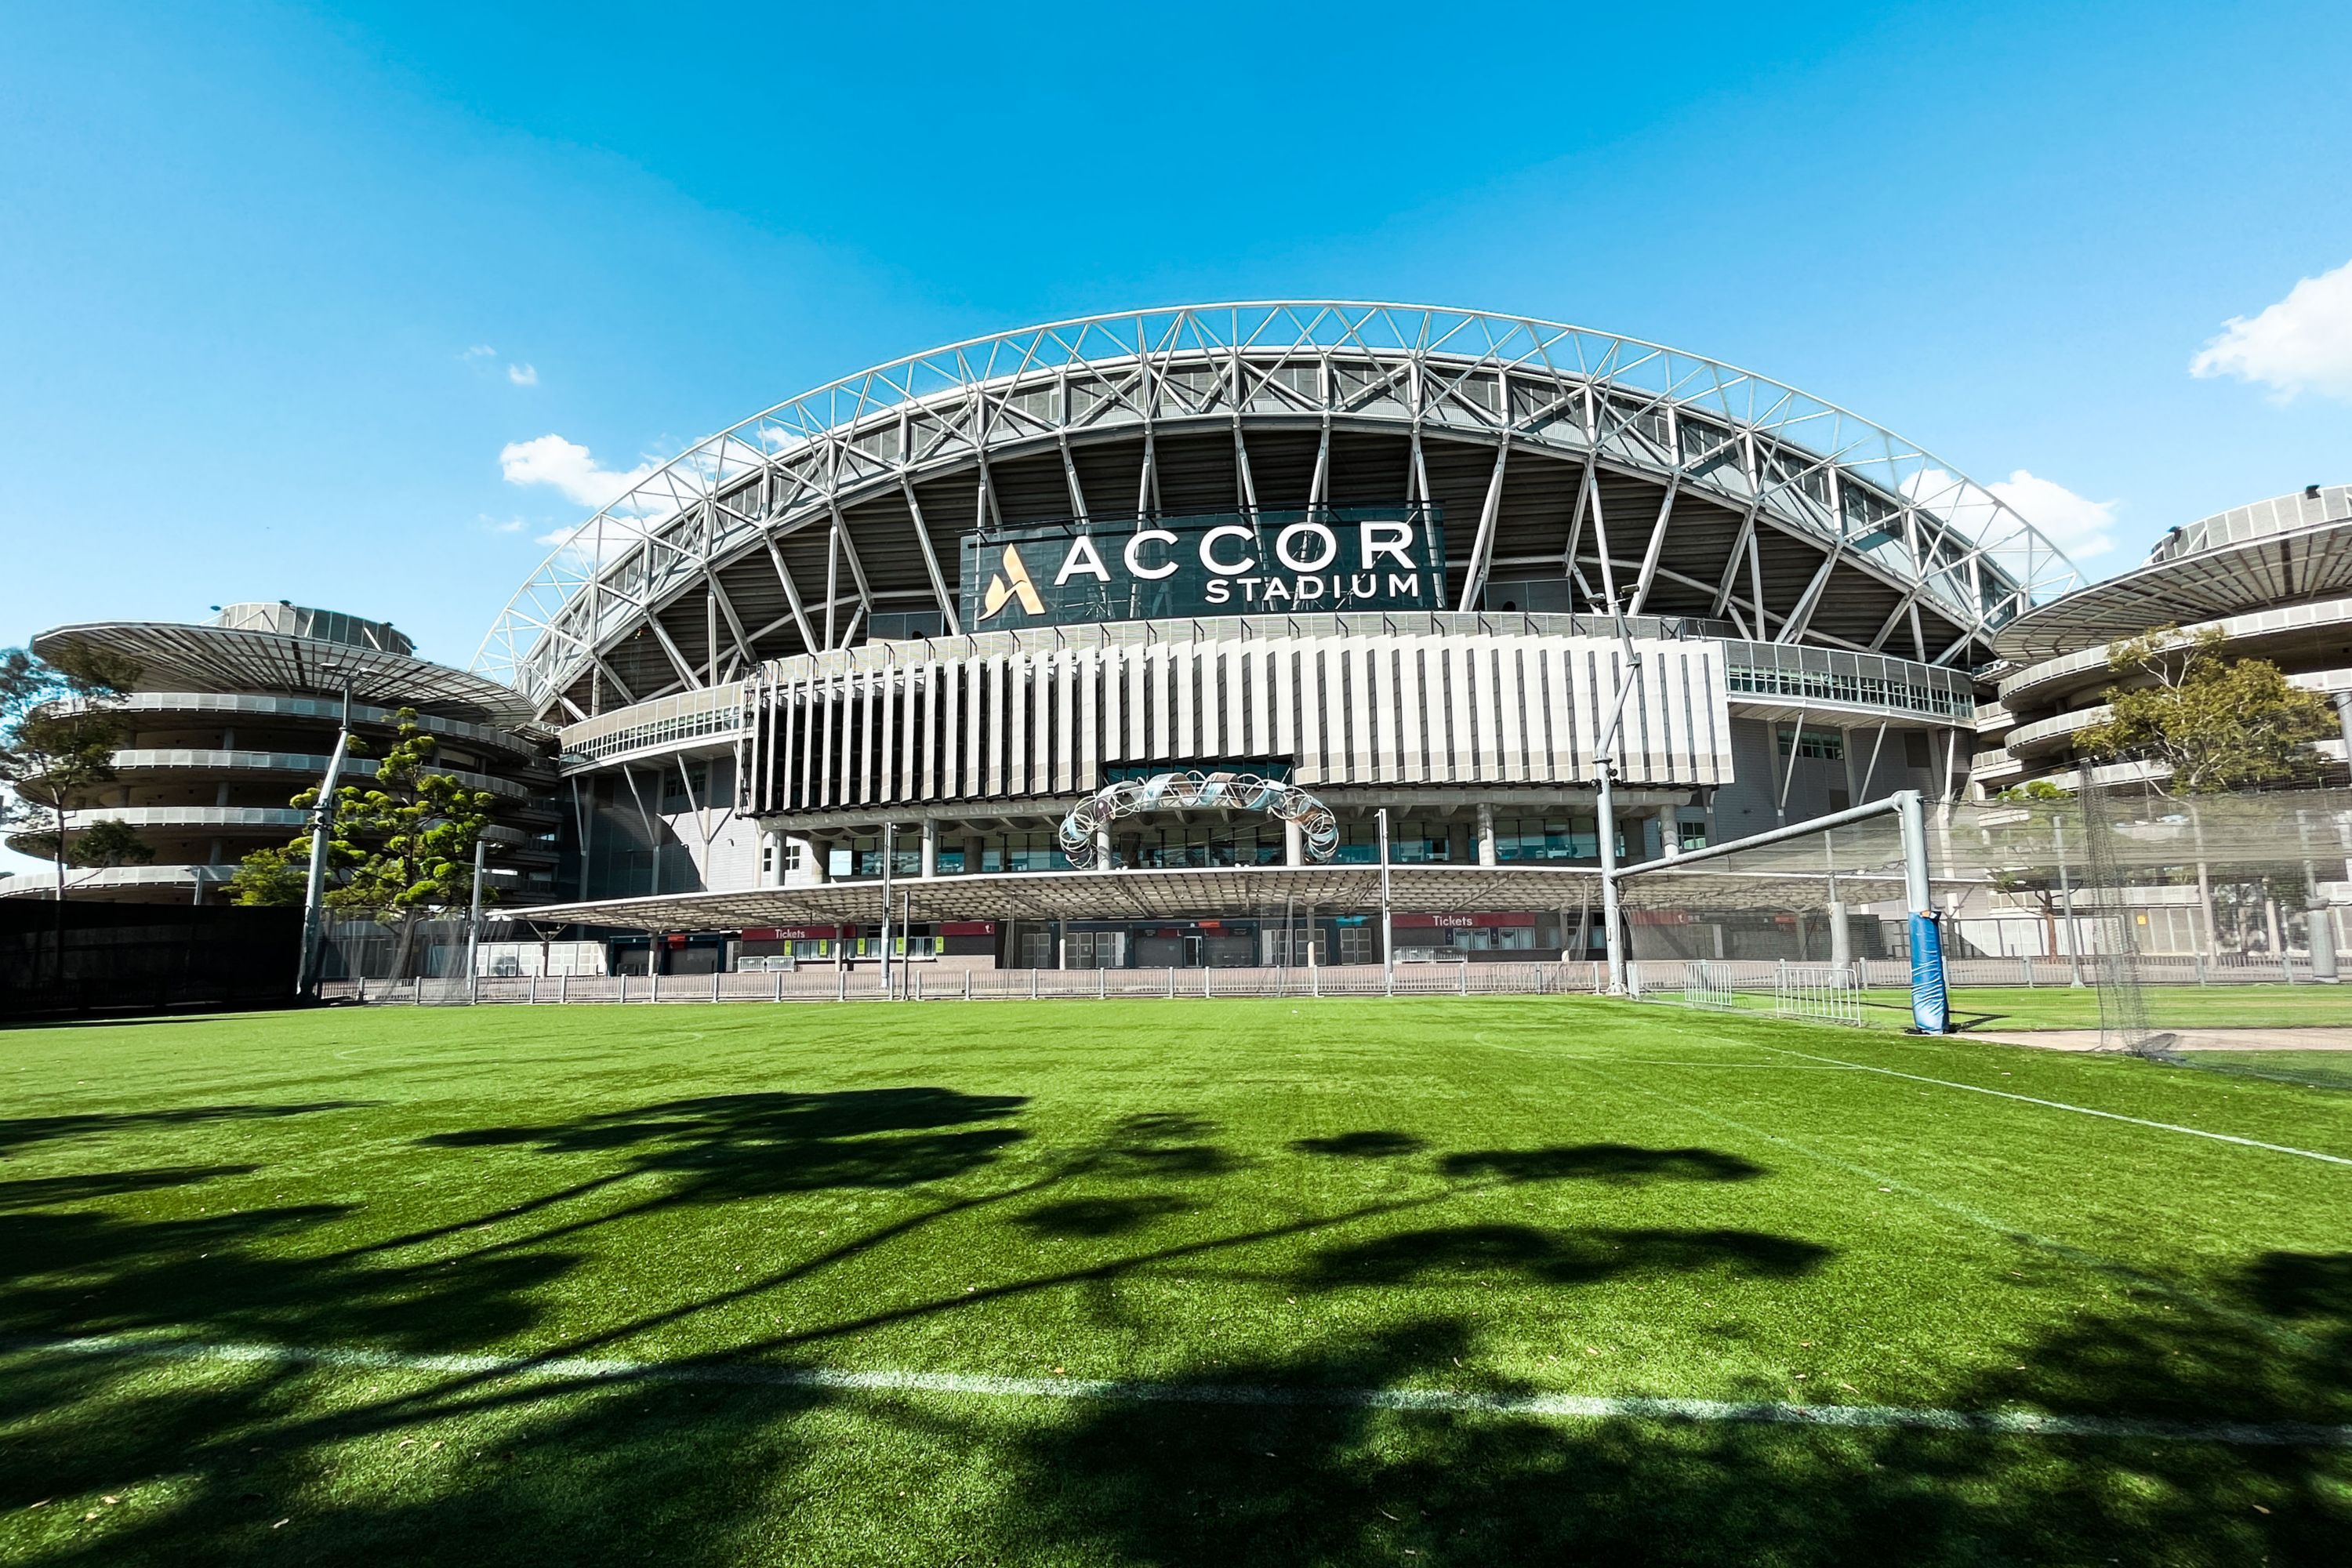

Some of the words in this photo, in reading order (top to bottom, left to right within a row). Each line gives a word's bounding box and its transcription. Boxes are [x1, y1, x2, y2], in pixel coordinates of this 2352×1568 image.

[1054, 521, 1417, 586] ACCOR
[1204, 573, 1418, 604] STADIUM
[1432, 915, 1473, 926] Tickets
[775, 928, 805, 939] Tickets
